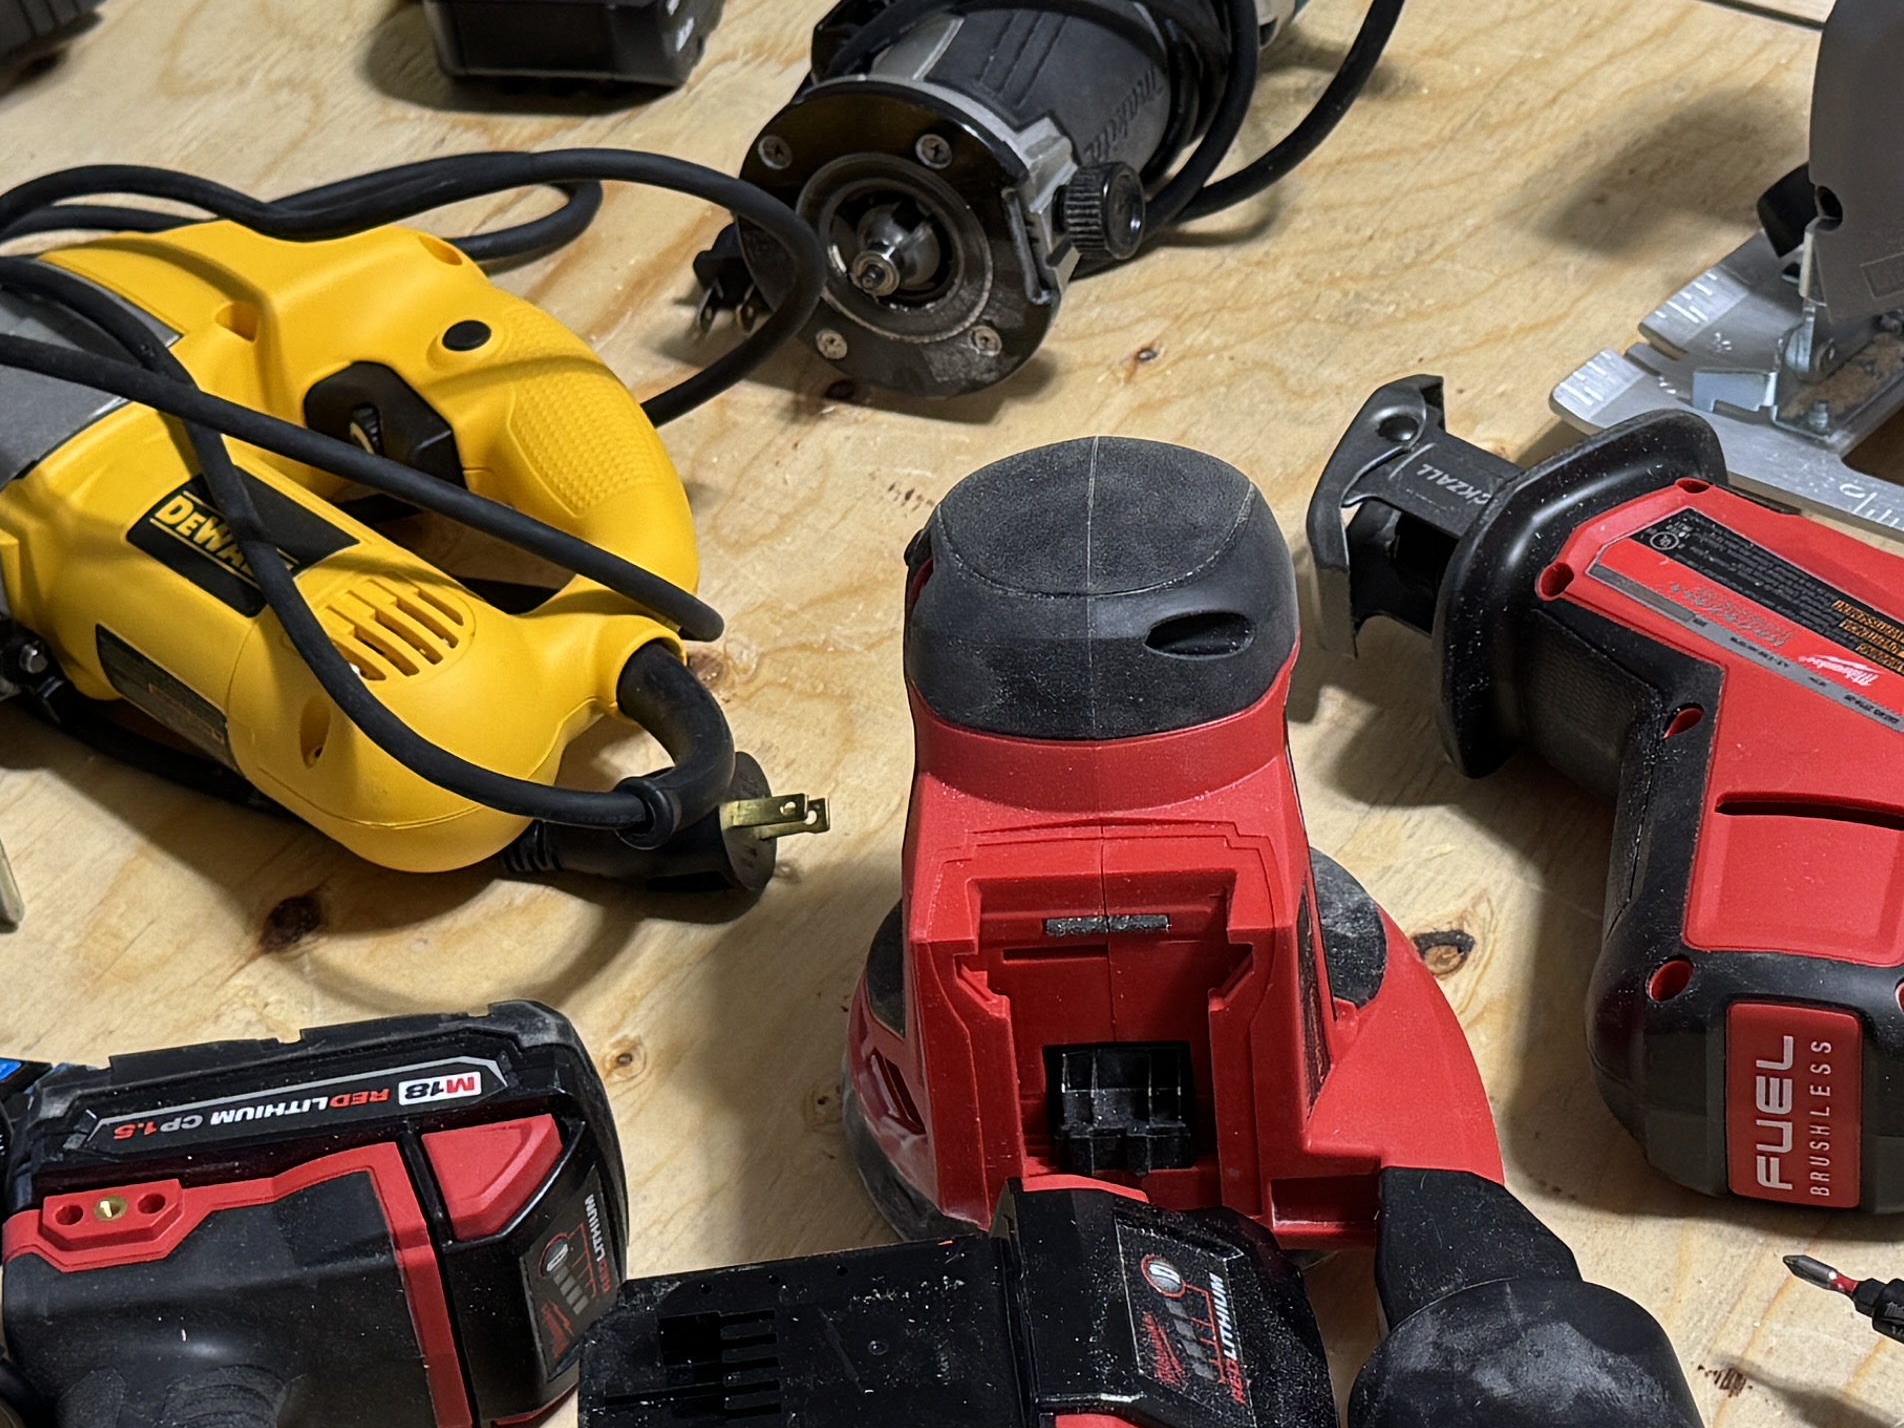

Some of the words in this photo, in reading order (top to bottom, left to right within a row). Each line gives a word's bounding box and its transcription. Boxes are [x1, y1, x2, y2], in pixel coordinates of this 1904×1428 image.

[1418, 463, 1493, 505] CKZALL
[1811, 656, 1874, 686] Milwaukee
[210, 1087, 390, 1125] REDLITHIUM
[403, 1074, 477, 1102] M18
[113, 1113, 204, 1141] CP1.5
[1754, 1035, 1795, 1191] FUEL
[1808, 1036, 1835, 1199] BRUSHLESS
